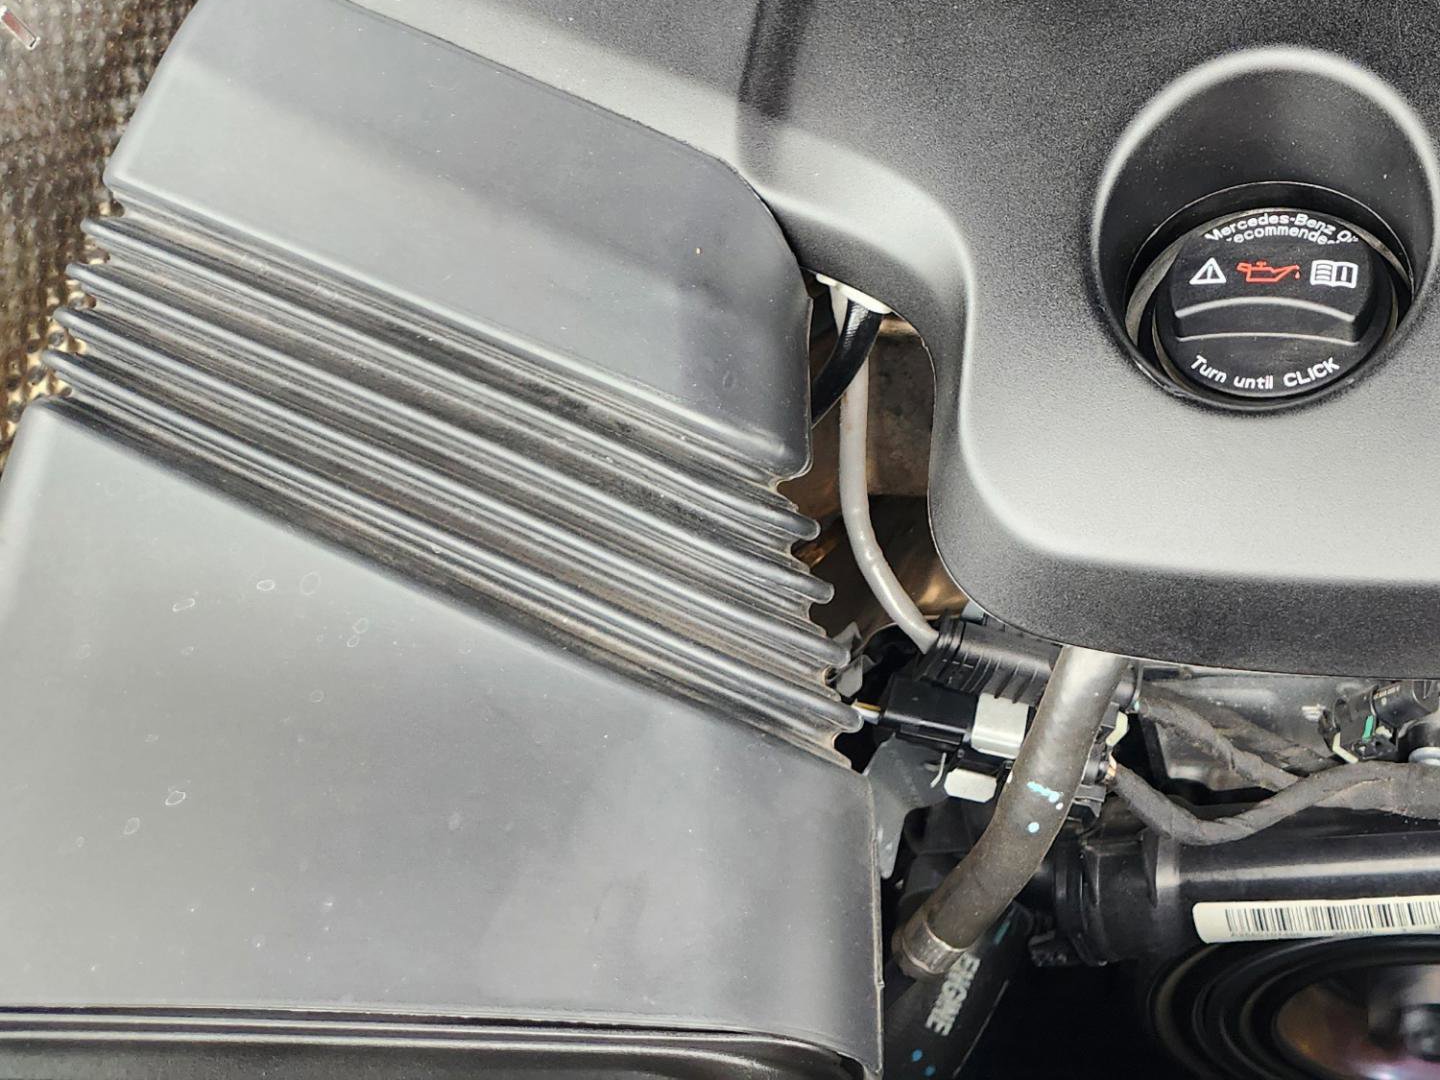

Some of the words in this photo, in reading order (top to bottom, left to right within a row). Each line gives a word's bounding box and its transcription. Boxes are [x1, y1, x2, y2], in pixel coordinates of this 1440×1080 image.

[1204, 213, 1336, 241] Mercedes-Benz
[1226, 225, 1340, 245] ecommende
[1191, 355, 1227, 383] Turn
[1233, 375, 1273, 389] until
[1283, 357, 1340, 387] CLICK
